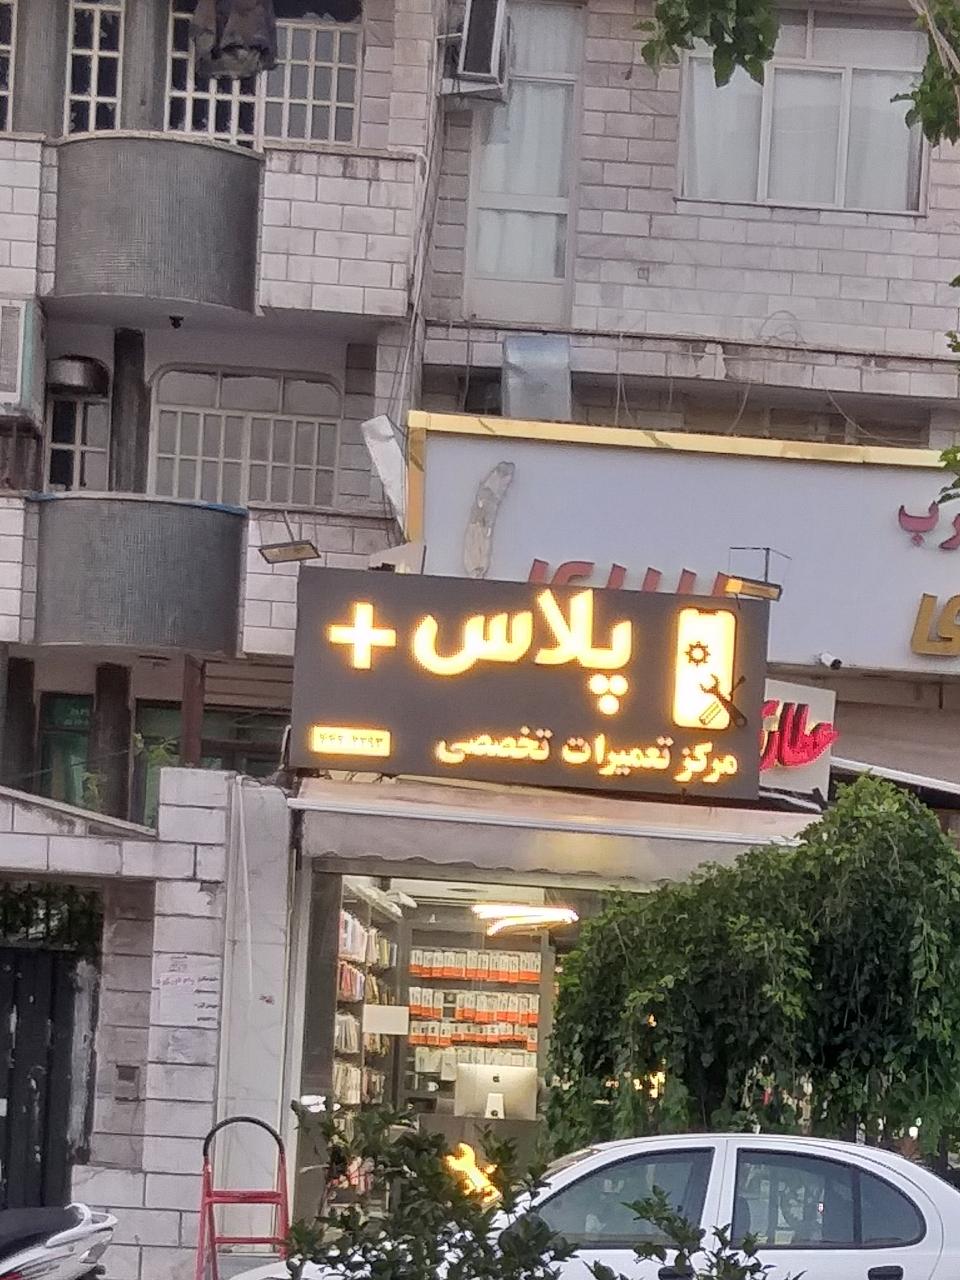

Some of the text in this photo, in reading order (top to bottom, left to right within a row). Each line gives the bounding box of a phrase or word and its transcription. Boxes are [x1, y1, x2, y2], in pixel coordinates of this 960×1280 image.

[413, 588, 632, 716] پلاس
[435, 724, 738, 783] مرکز تعمیرات تخصصی
